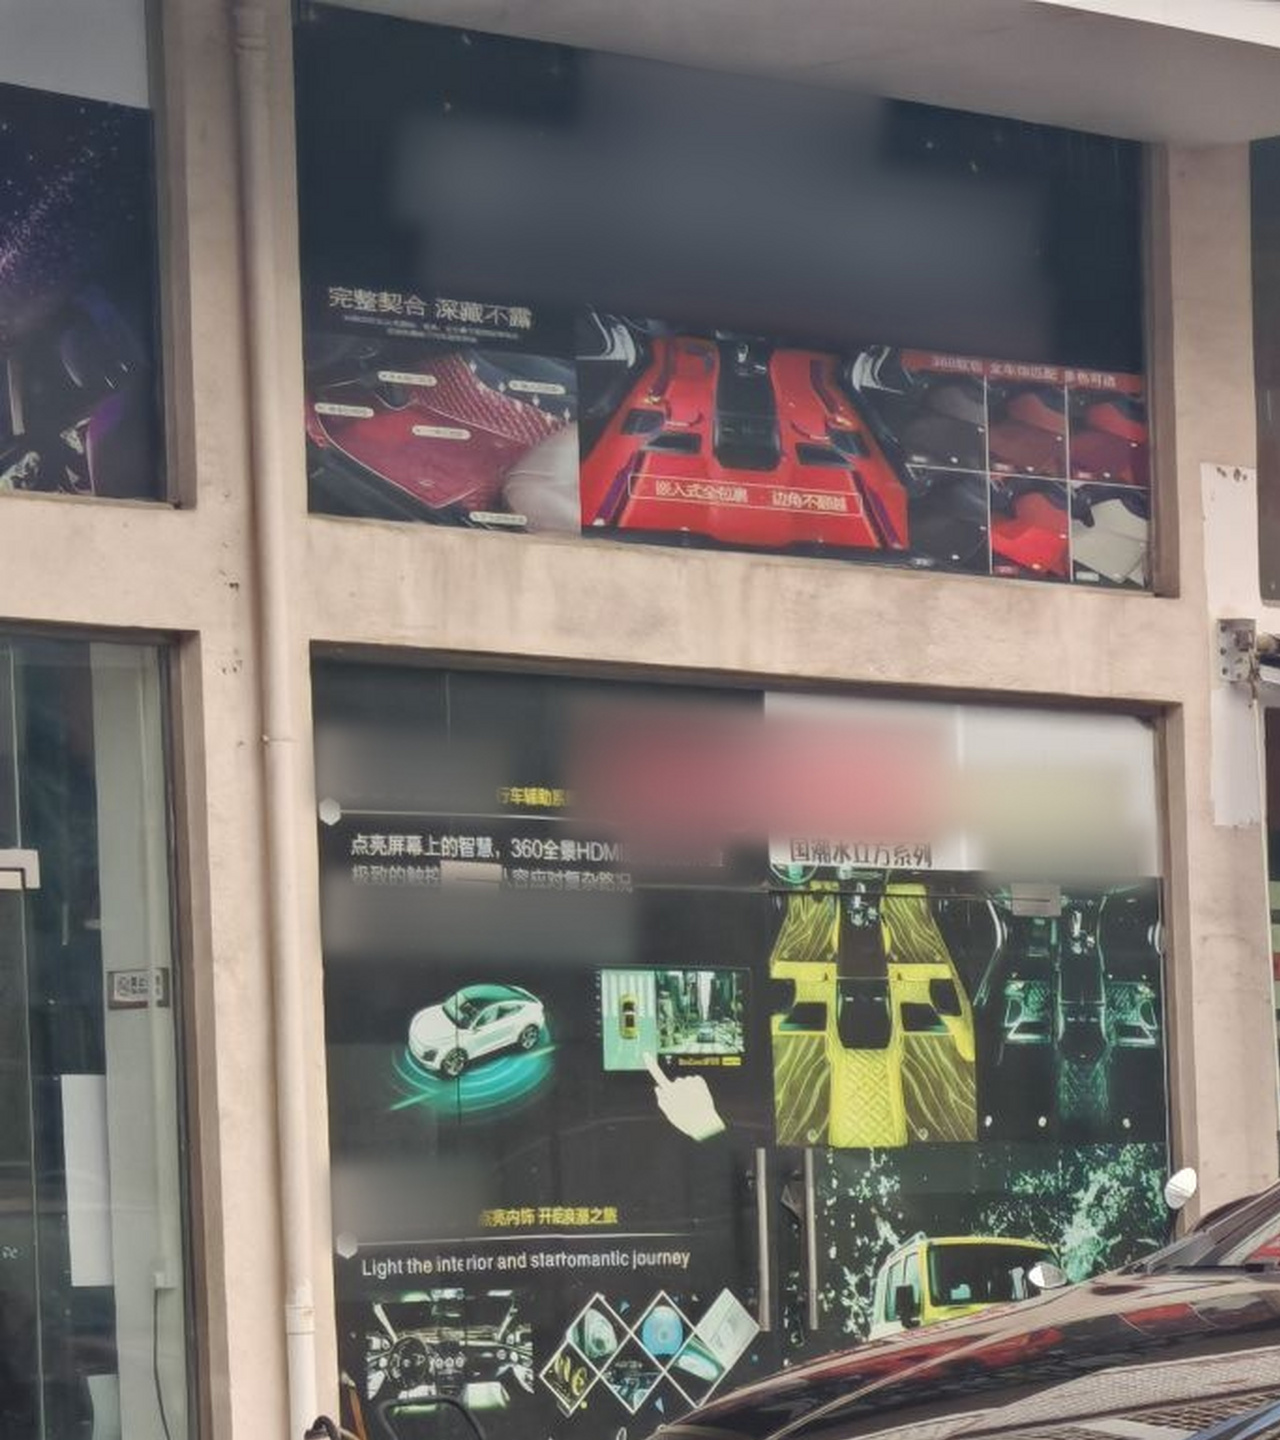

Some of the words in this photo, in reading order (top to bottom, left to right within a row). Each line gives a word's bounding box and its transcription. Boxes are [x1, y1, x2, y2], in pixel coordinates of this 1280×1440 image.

[361, 1257, 403, 1280] Light
[407, 1256, 432, 1275] the
[497, 1251, 528, 1270] and
[632, 1248, 692, 1270] journey
